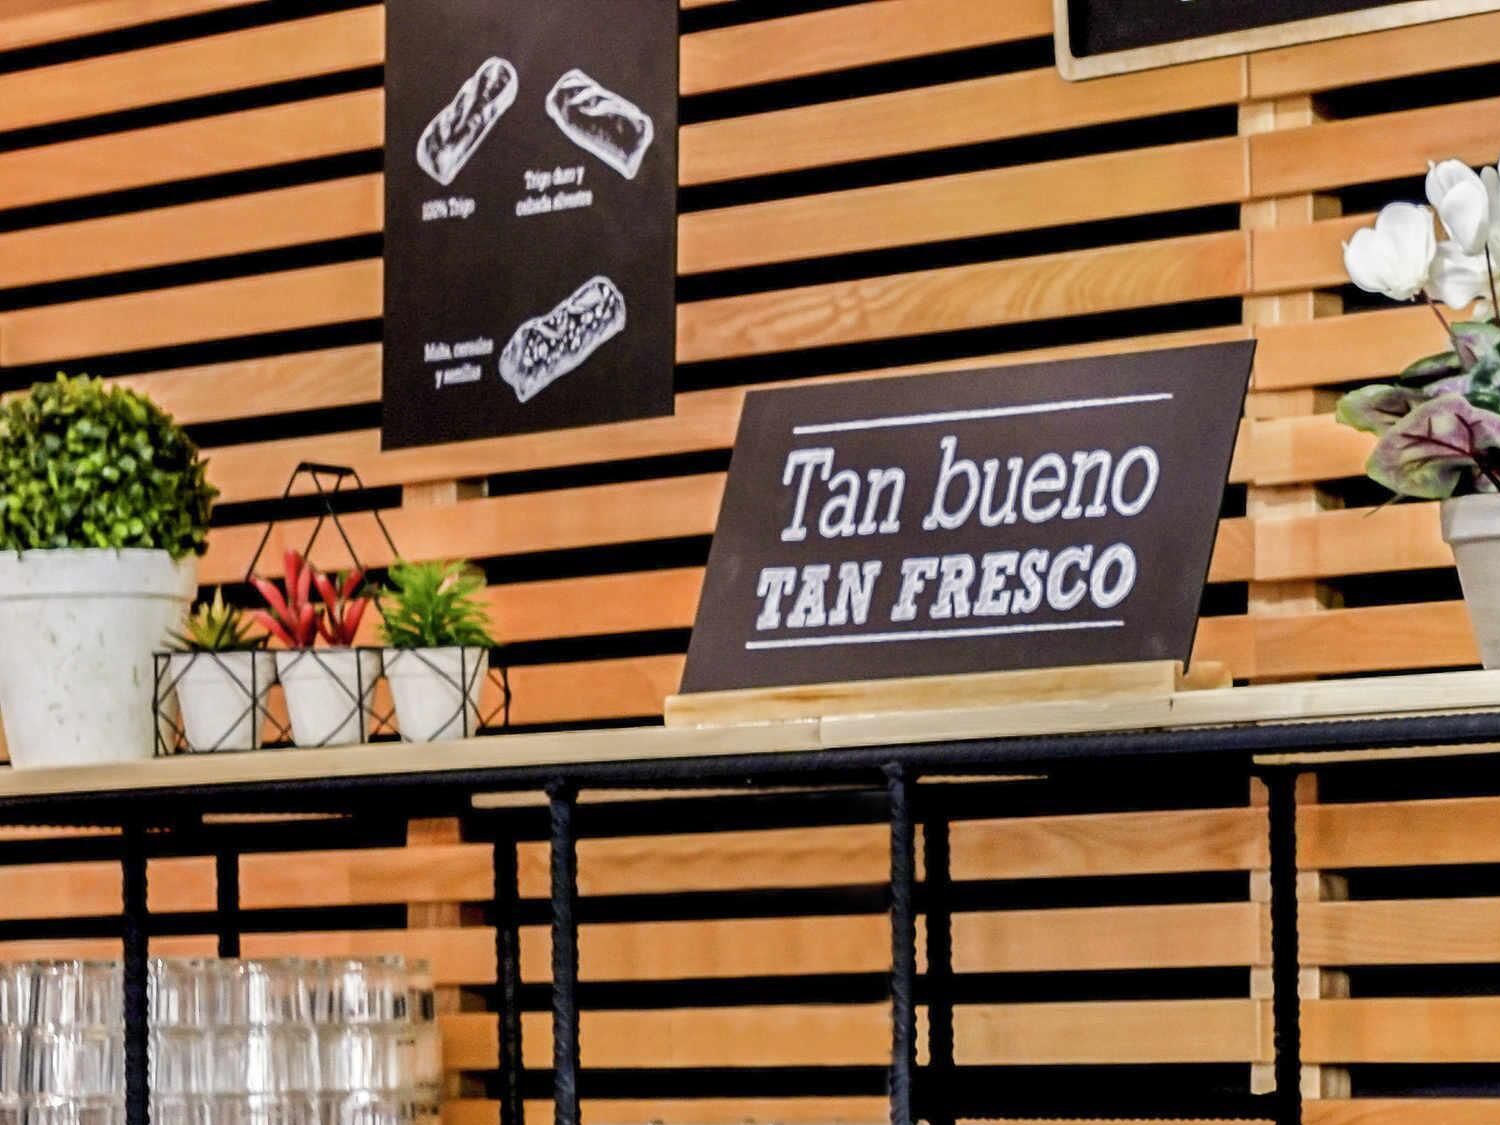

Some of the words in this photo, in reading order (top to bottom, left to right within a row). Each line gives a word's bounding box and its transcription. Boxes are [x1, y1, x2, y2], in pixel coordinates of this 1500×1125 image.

[781, 446, 905, 542] Tan
[922, 434, 1160, 531] bueno
[755, 560, 882, 631] TAN
[890, 541, 1136, 622] FRESCO
